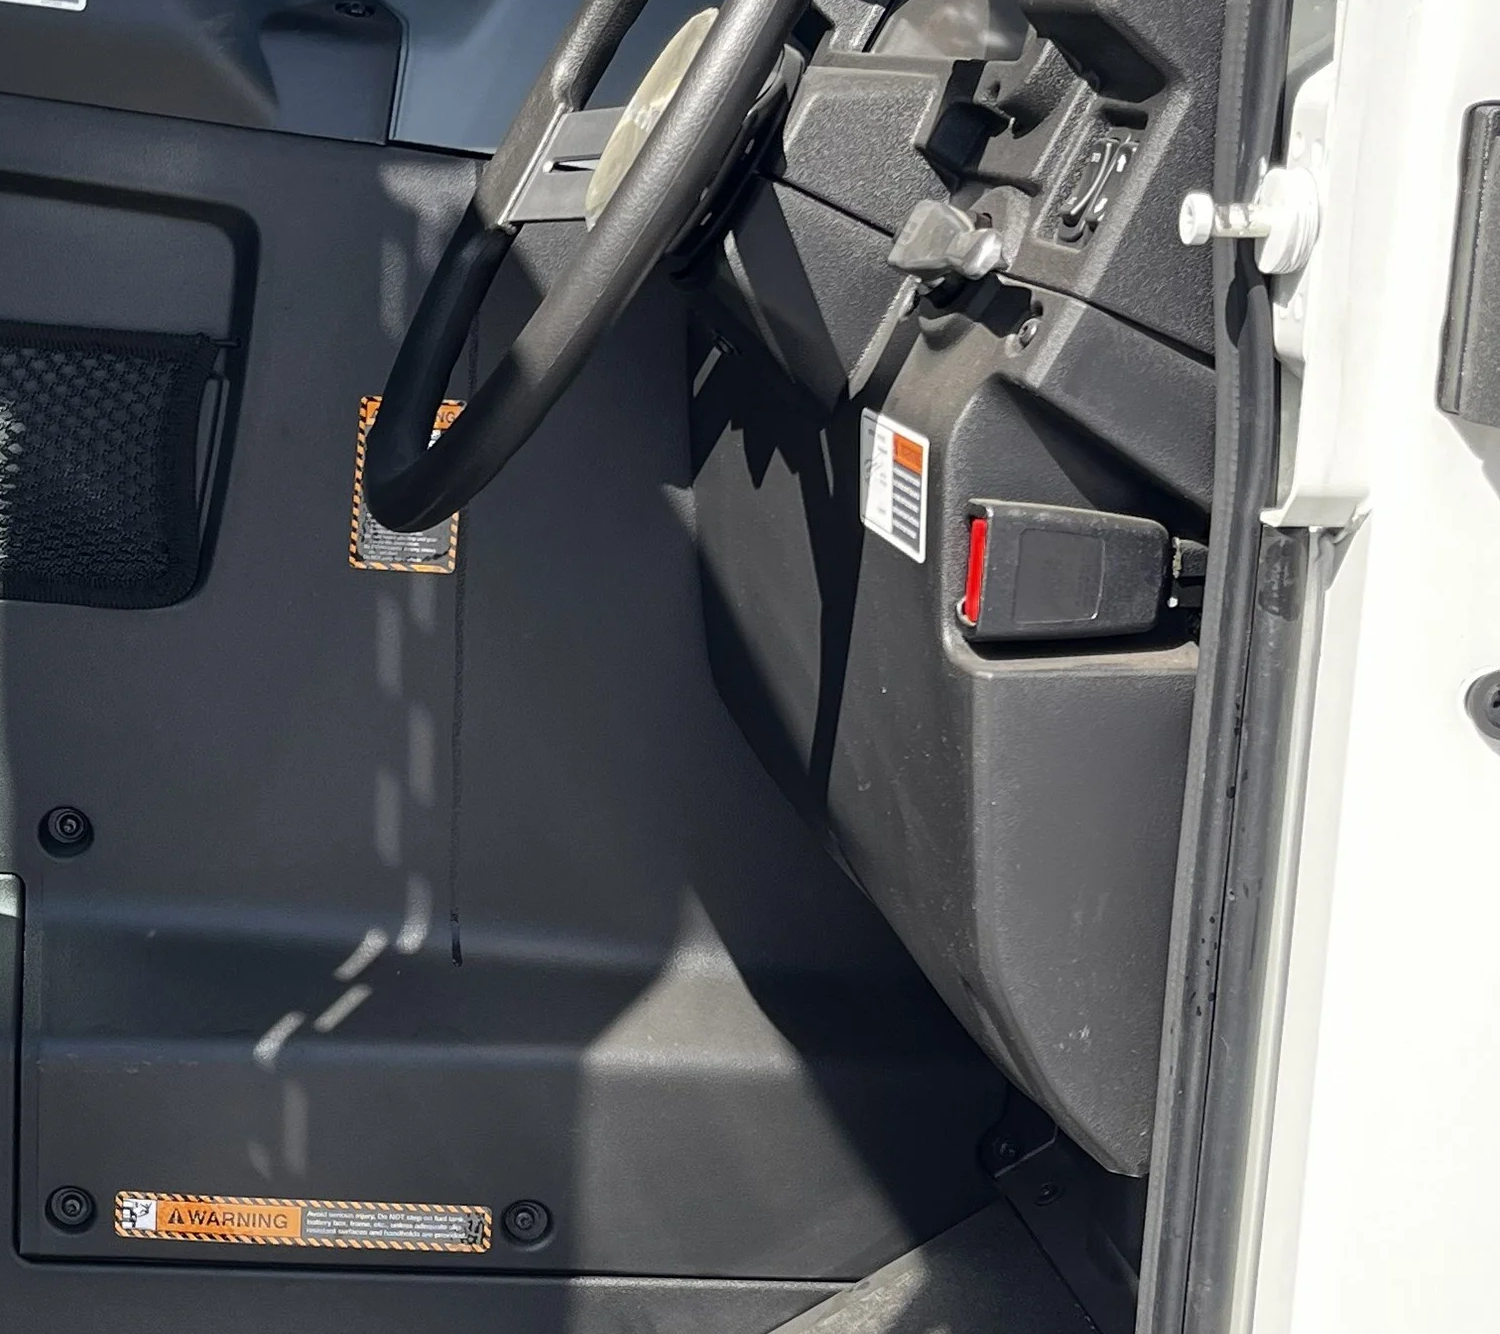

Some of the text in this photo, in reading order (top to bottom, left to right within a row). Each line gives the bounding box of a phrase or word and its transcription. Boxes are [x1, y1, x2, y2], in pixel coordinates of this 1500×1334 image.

[187, 1210, 288, 1229] WARNING
[306, 1210, 328, 1218] Avoid
[406, 1215, 422, 1223] step
[306, 1219, 331, 1227] battery
